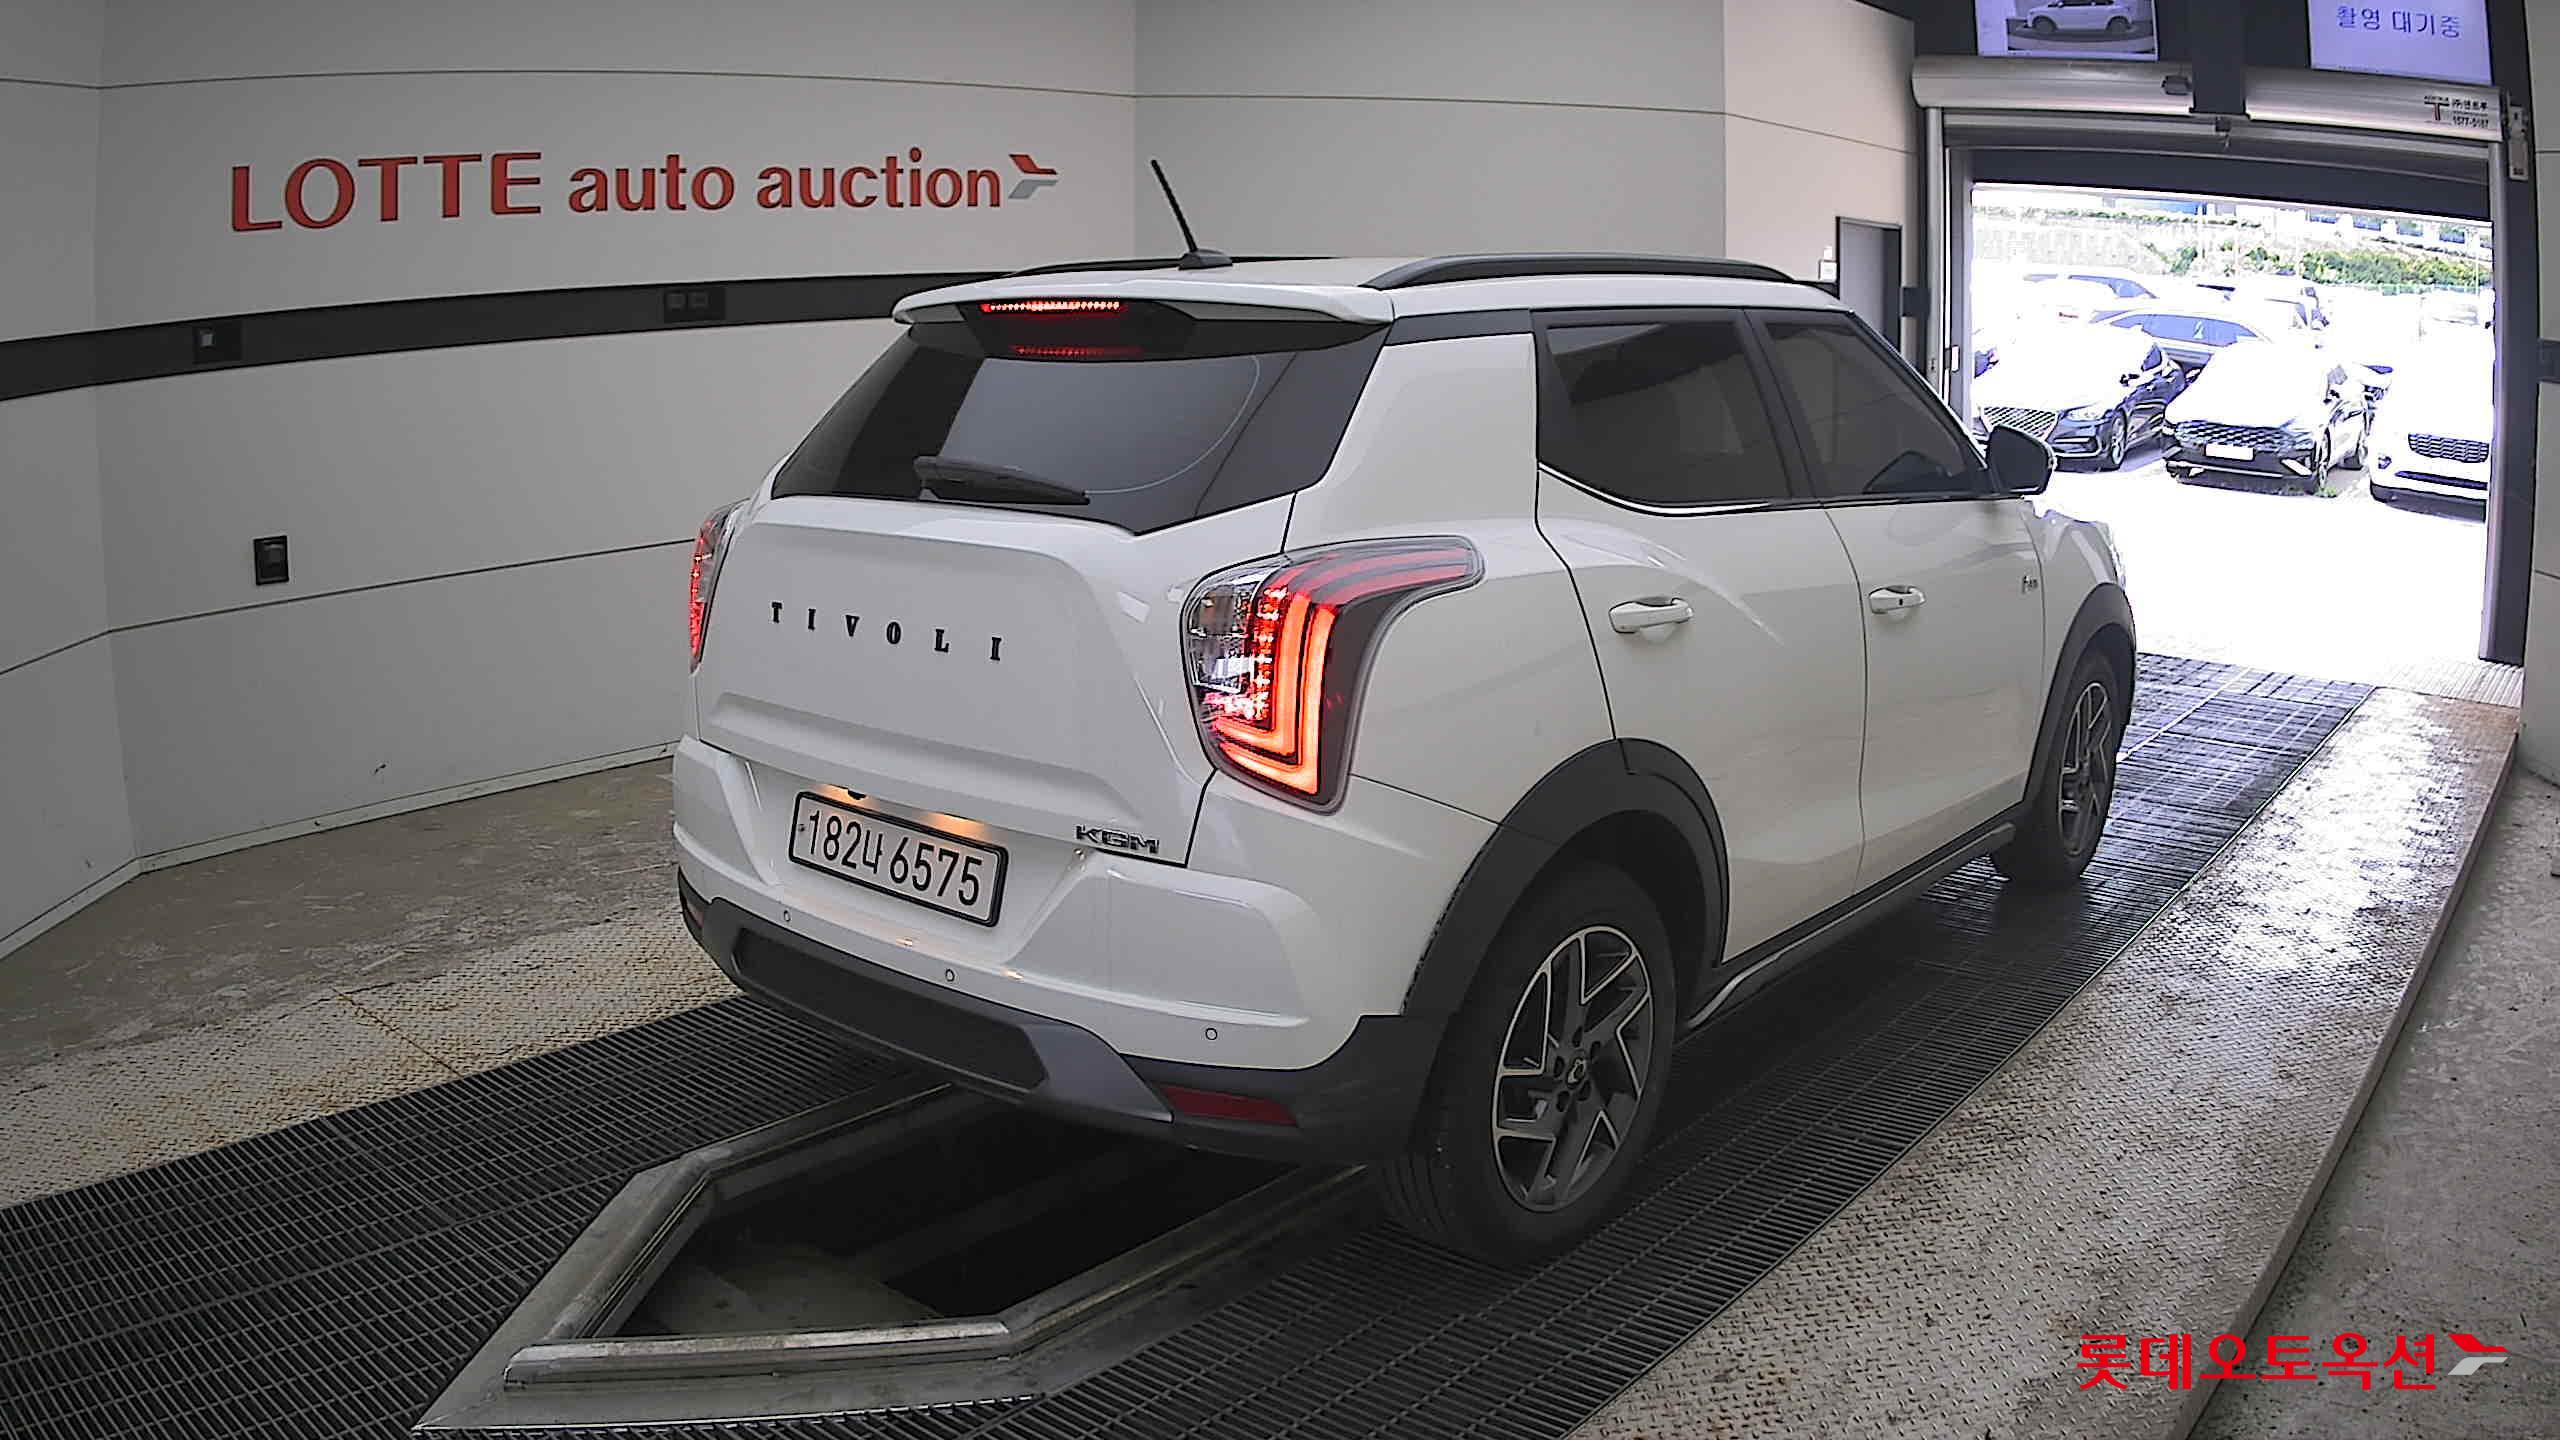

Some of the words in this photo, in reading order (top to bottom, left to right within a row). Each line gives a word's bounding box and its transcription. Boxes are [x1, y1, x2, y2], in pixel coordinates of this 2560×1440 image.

[2337, 6, 2380, 30] 촬영
[2391, 10, 2460, 38] 대기중
[231, 151, 543, 233] LOTTE
[568, 153, 735, 213] auto
[757, 146, 1002, 210] auction
[771, 601, 1002, 662] TIVOLI
[810, 809, 884, 874] 182나
[889, 836, 983, 906] 6575
[1075, 825, 1160, 854] KGM
